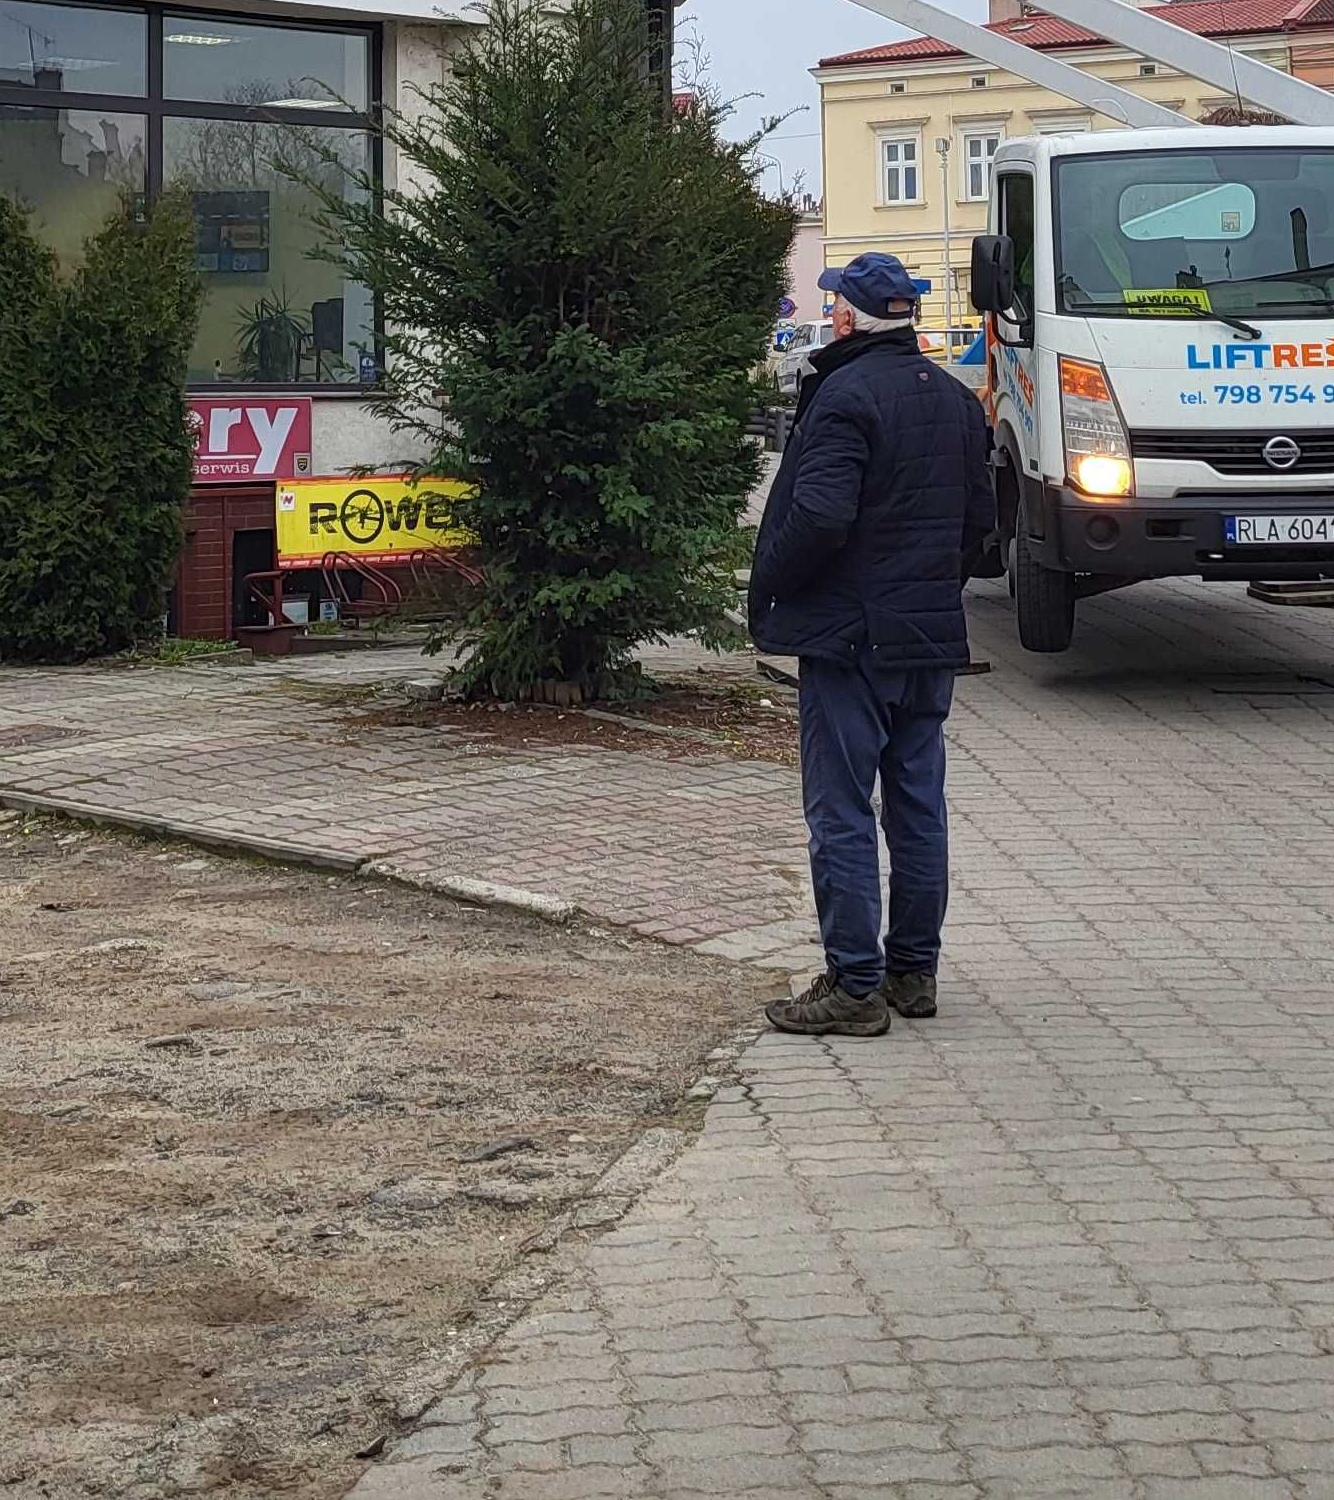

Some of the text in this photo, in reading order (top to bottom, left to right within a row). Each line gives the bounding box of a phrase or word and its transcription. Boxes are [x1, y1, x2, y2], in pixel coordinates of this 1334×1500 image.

[1179, 390, 1207, 405] tel.
[1213, 384, 1262, 404] 798
[1269, 384, 1316, 404] 754
[192, 462, 250, 475] serwis
[309, 488, 467, 544] ROWE
[1238, 518, 1280, 542] RLA
